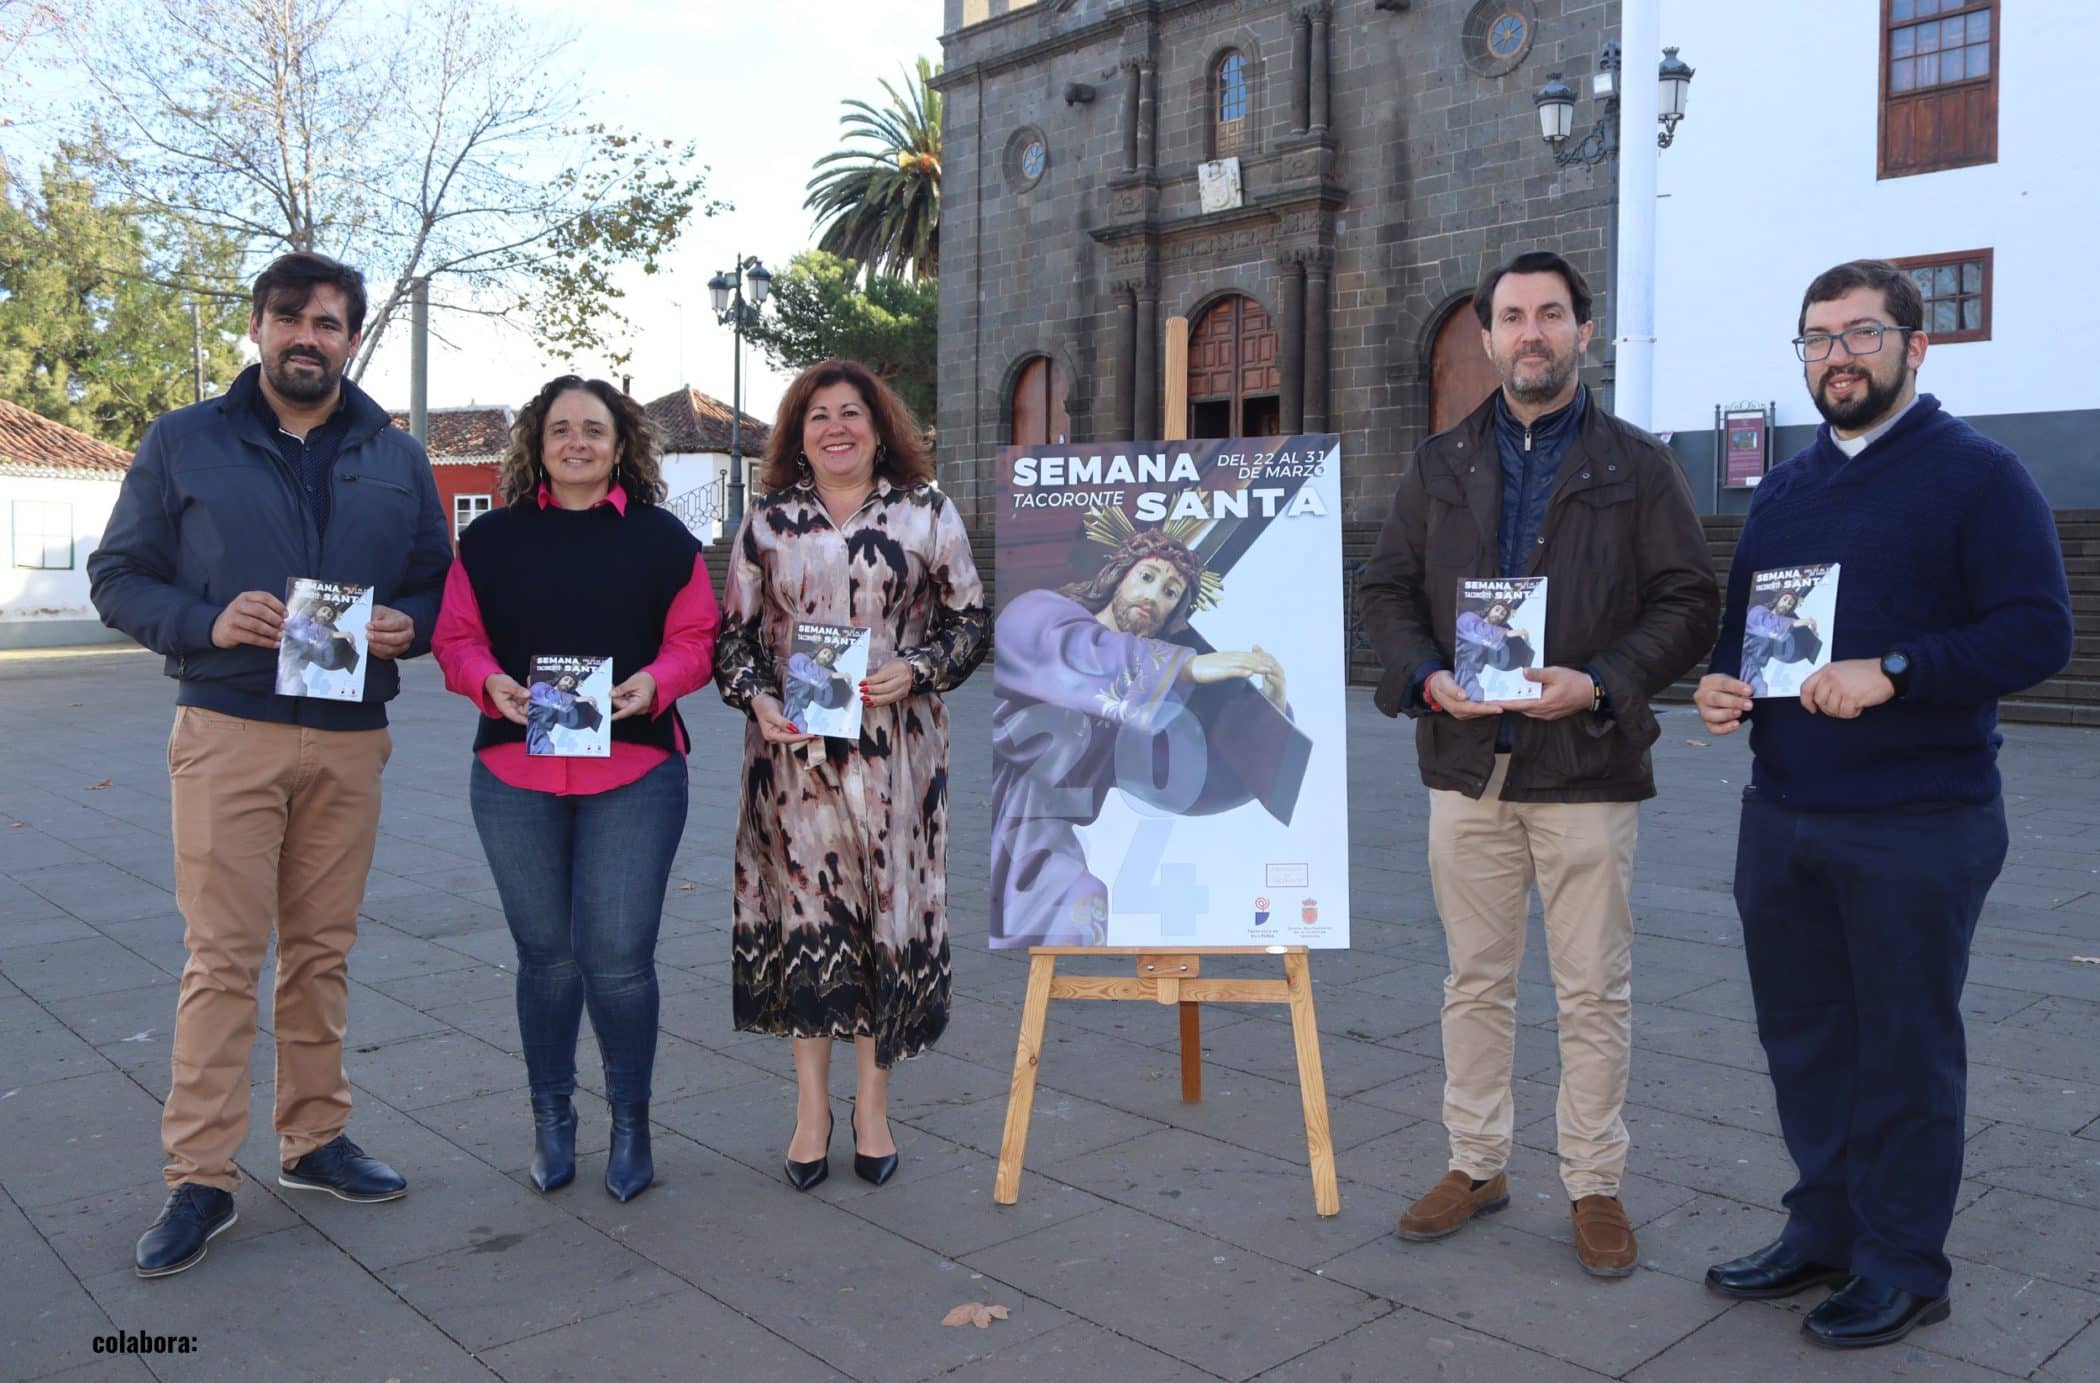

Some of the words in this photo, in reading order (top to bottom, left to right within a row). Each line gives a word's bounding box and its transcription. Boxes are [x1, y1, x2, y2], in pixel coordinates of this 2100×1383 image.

[1217, 453, 1248, 467] DEL
[1253, 452, 1275, 465] 22
[1279, 451, 1299, 464] AL
[1304, 450, 1326, 463] 31
[1012, 453, 1200, 486] SEMANA
[1238, 466, 1261, 479] DE
[1265, 464, 1325, 478] MARZO
[1013, 490, 1125, 509] TACORONTE
[1135, 486, 1329, 522] SANTA
[1756, 569, 1800, 583] SEMANA
[1464, 581, 1512, 590] SEMANA
[799, 624, 840, 635] SEMANA
[536, 656, 580, 665] SEMANA
